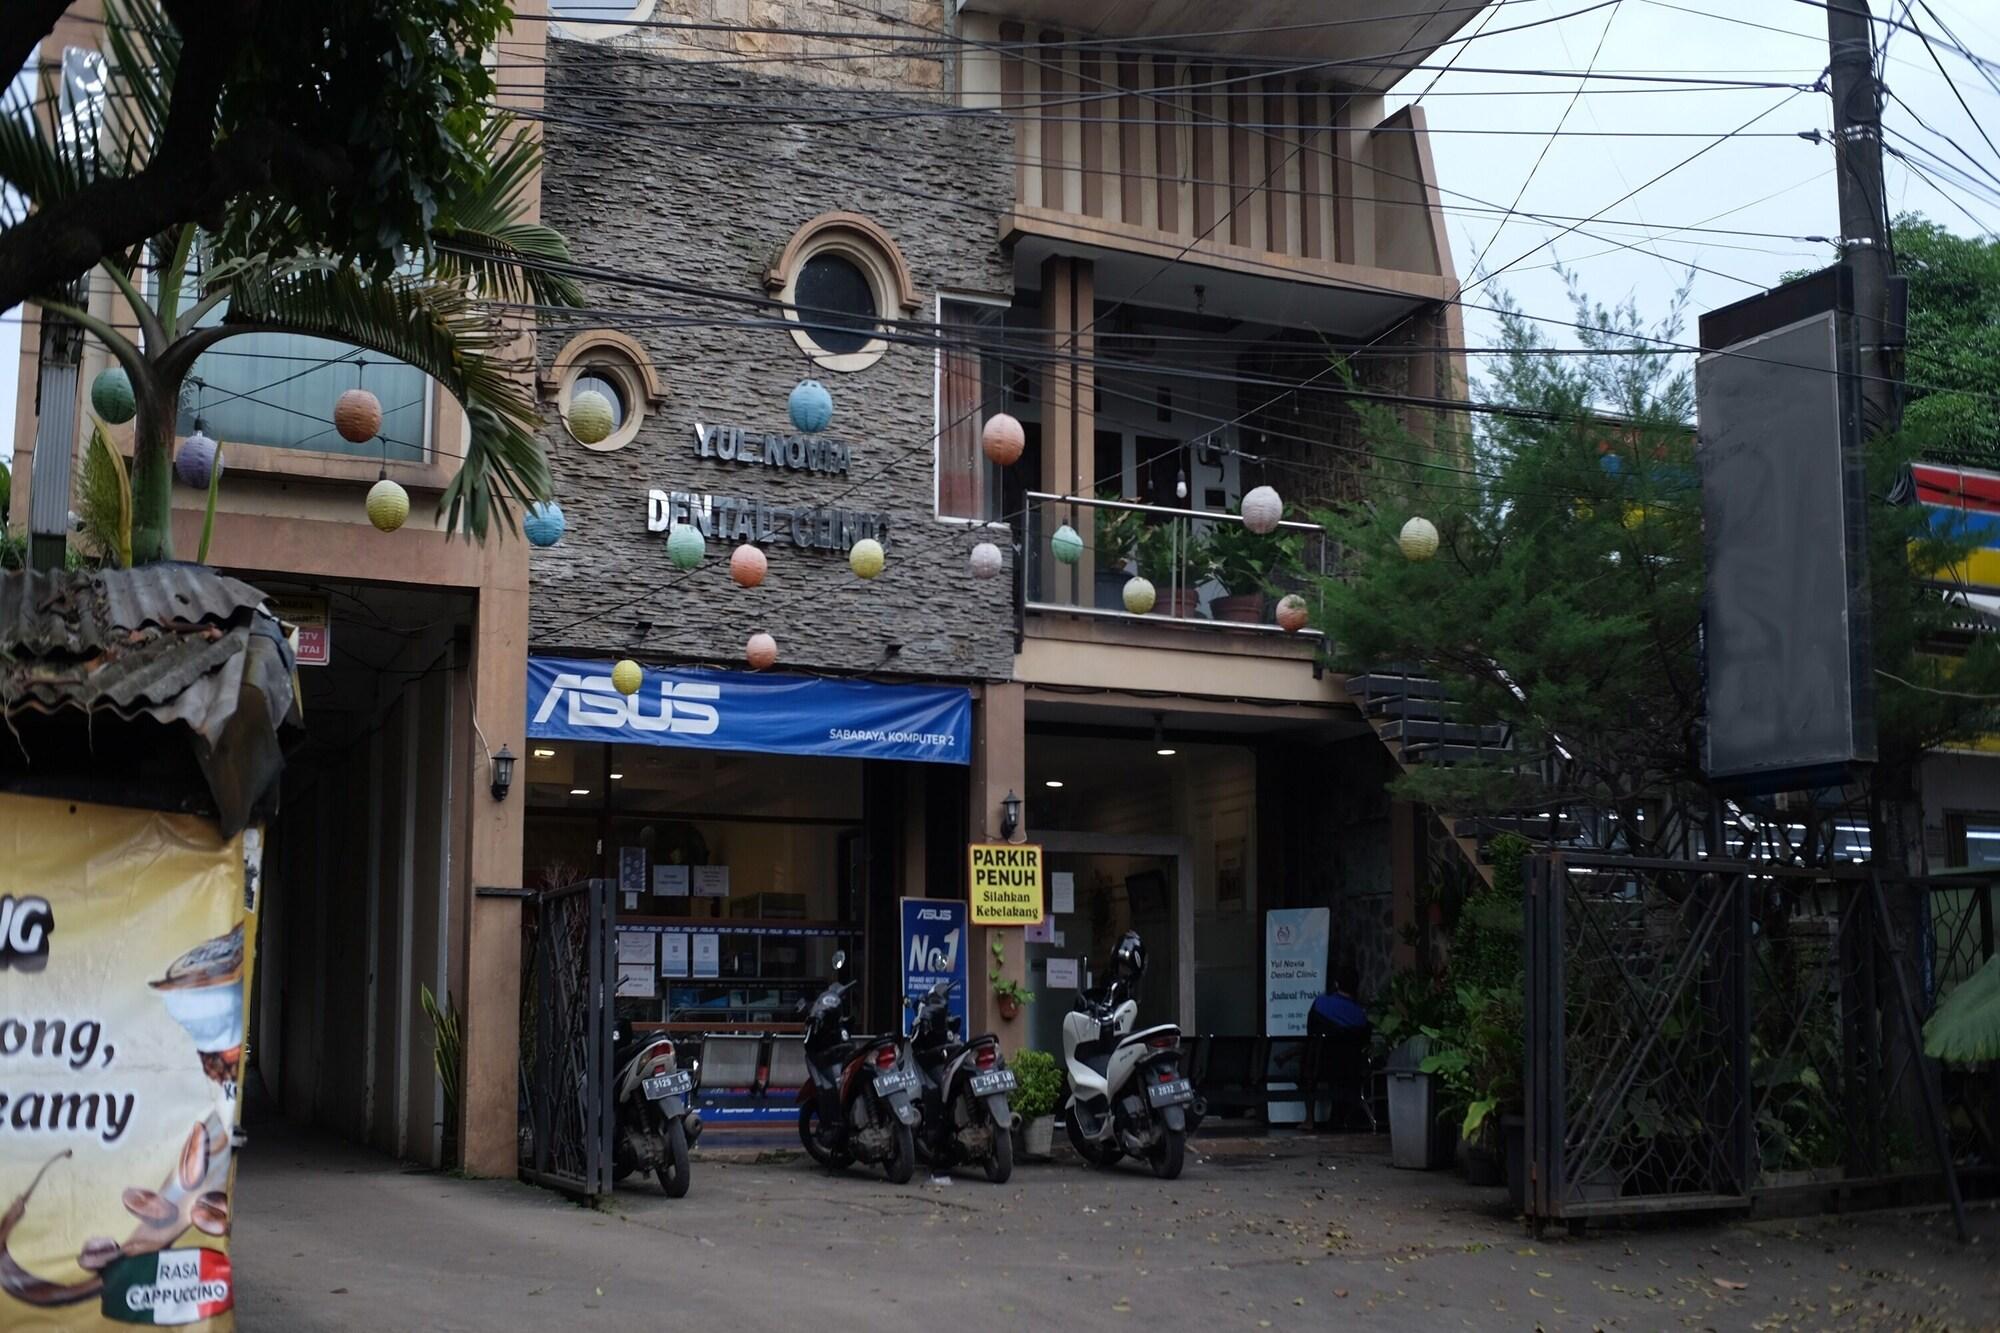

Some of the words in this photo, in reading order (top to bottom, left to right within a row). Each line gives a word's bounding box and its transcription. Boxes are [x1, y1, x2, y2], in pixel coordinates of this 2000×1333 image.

[647, 489, 776, 544] DENTAL
[533, 674, 721, 735] ASUS
[829, 728, 886, 742] SABARAYA
[888, 732, 947, 746] KOMPUTER
[948, 735, 955, 746] 2
[973, 849, 1037, 867] PARKIR
[976, 869, 1036, 886] PENUH
[983, 890, 1030, 902] Silahkan
[917, 908, 953, 920] ASUS
[976, 905, 1039, 919] Kebelakang
[160, 1263, 199, 1280] RASA
[128, 1284, 226, 1306] CAPPUCCINO
